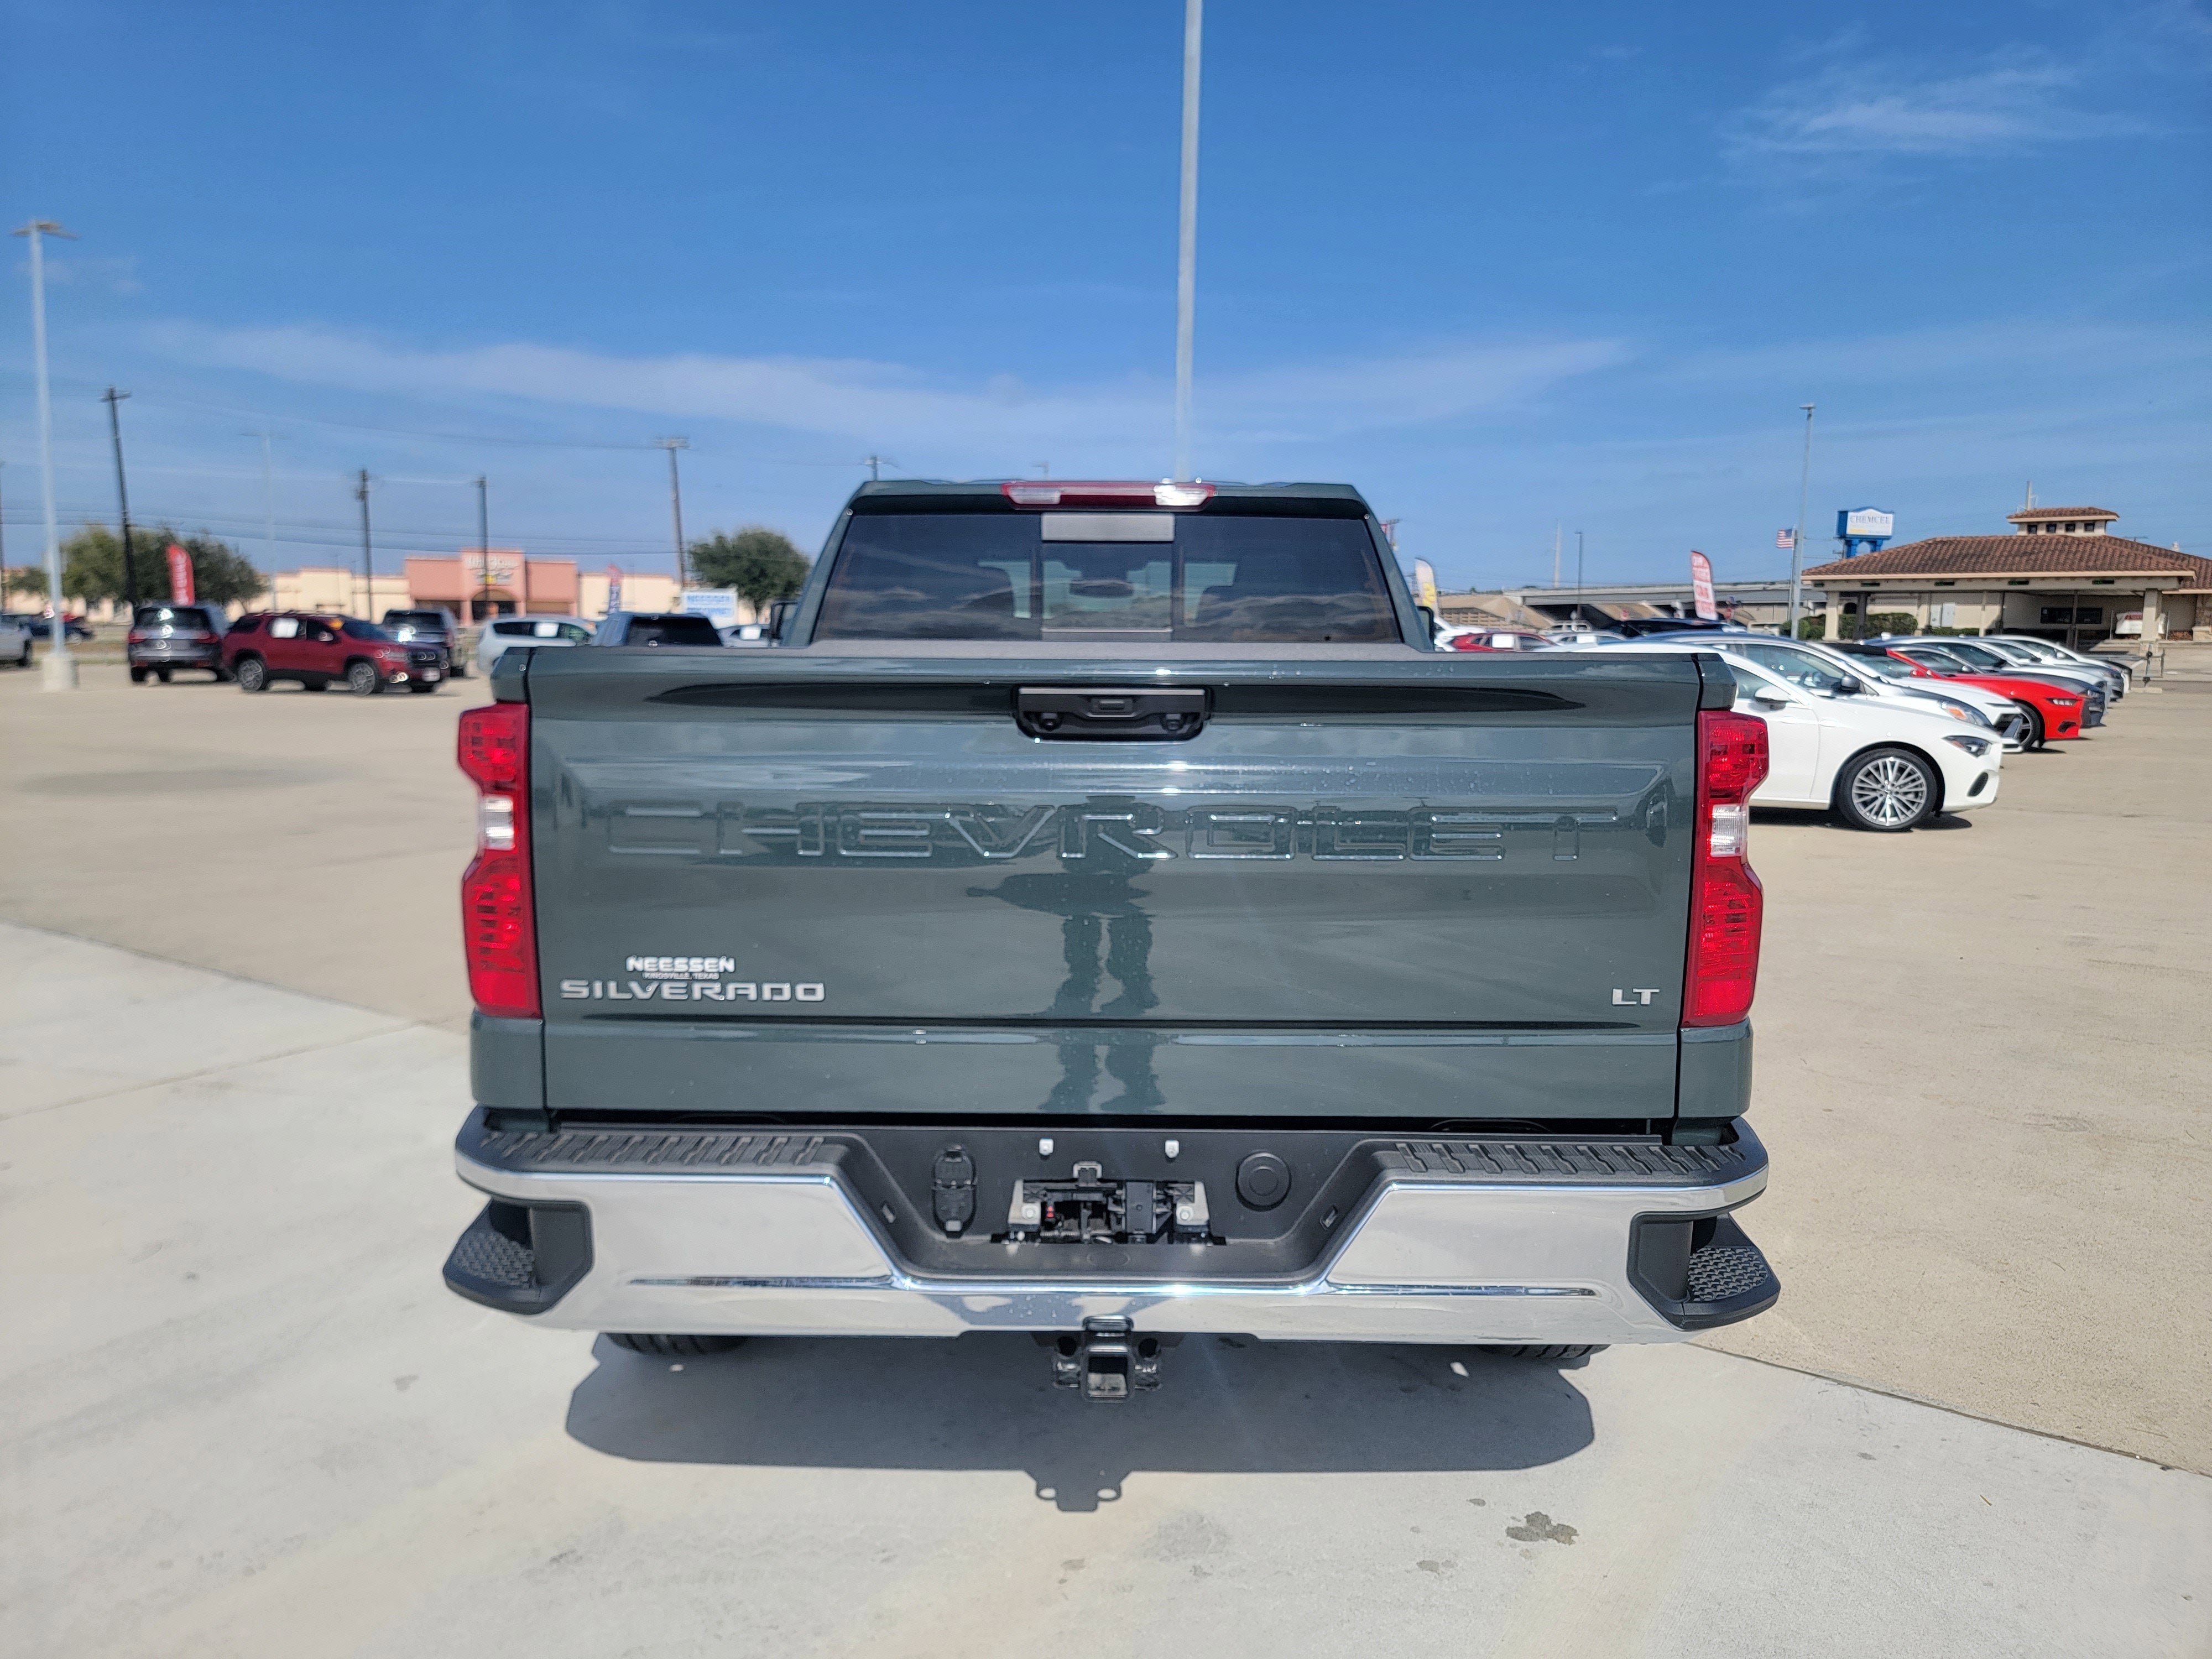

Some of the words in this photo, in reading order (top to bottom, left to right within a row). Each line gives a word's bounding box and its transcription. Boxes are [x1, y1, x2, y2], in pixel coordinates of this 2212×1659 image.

[609, 800, 1619, 862] CHEVROLET
[626, 956, 735, 972] NEESSEN
[560, 979, 825, 1001] SILVERADO
[1612, 988, 1660, 1005] LT
